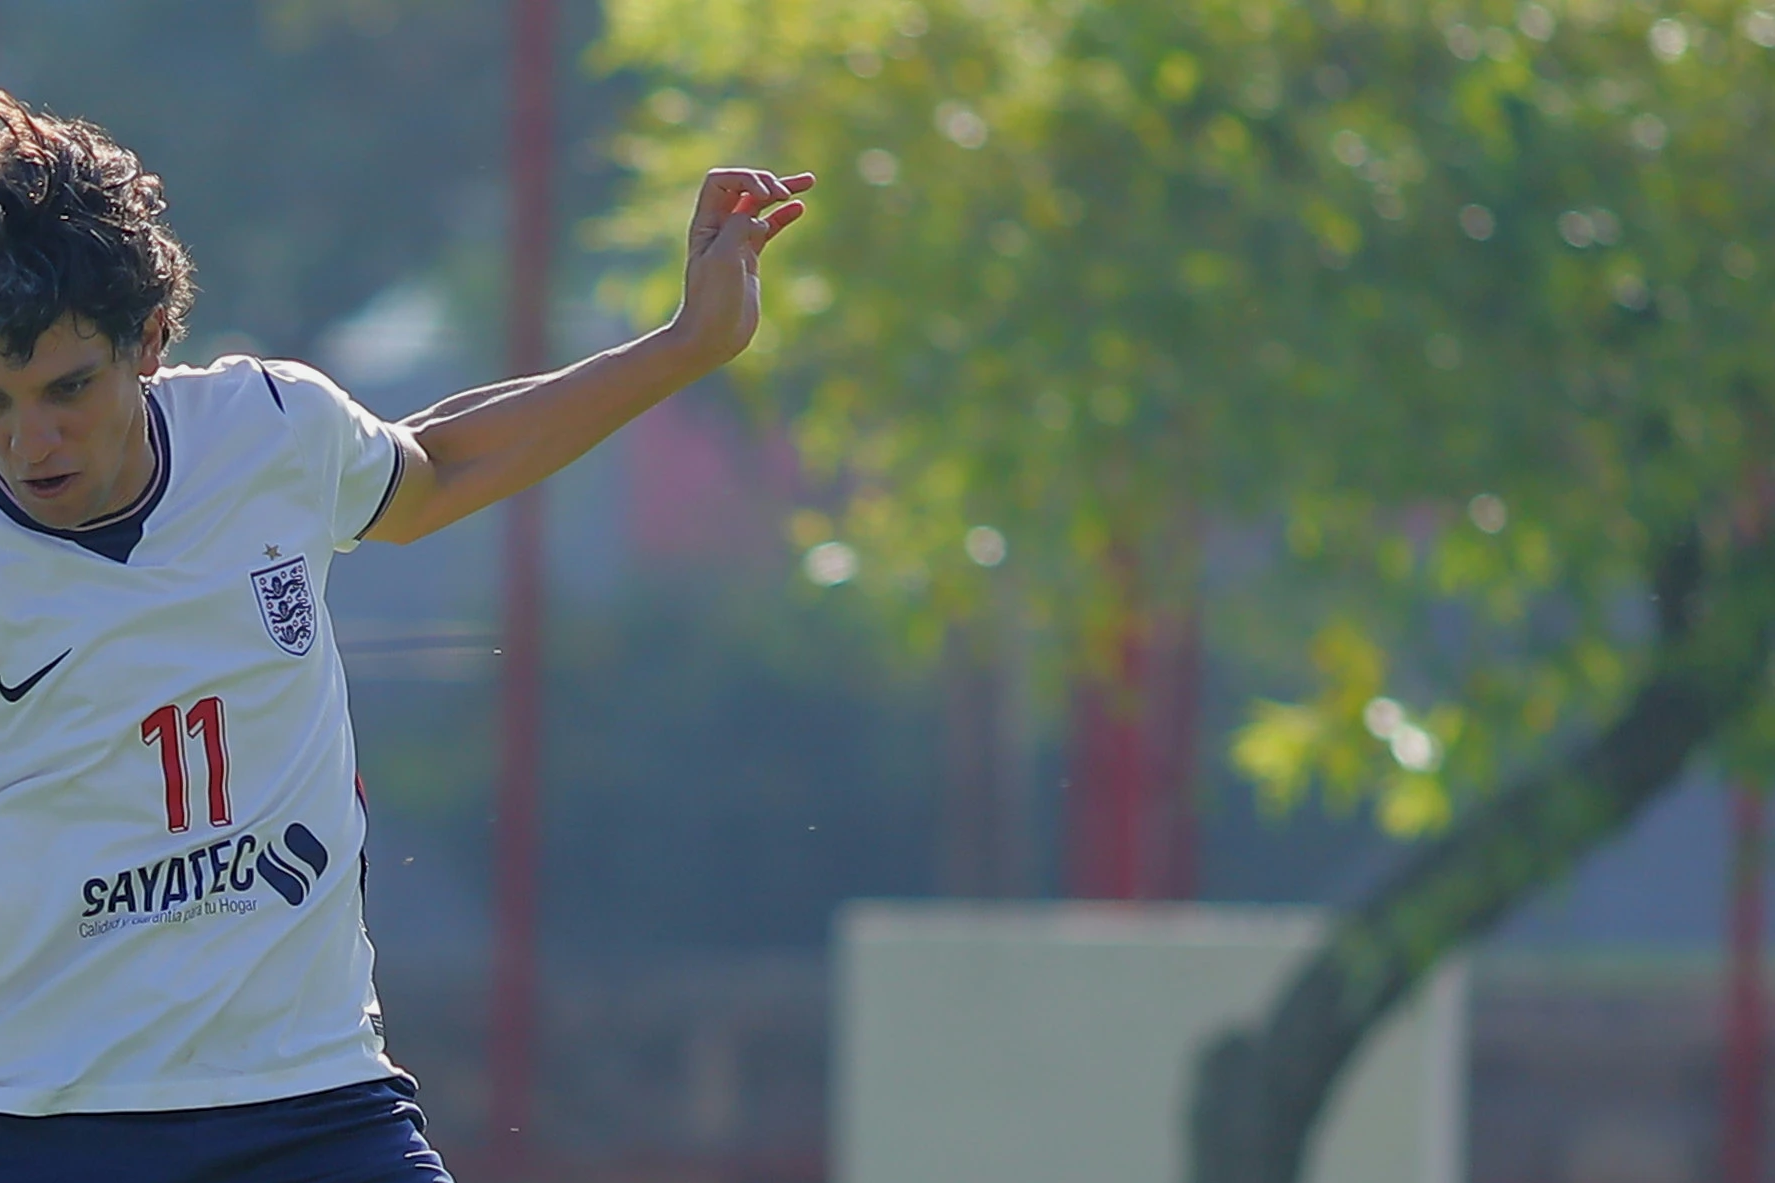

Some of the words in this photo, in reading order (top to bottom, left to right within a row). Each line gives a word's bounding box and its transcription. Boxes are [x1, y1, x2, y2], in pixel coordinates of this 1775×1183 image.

[141, 696, 231, 833] 11
[82, 834, 256, 917] SAYATEC
[78, 917, 121, 938] Calidd
[205, 901, 217, 915] tu
[219, 897, 257, 915] Hogar
